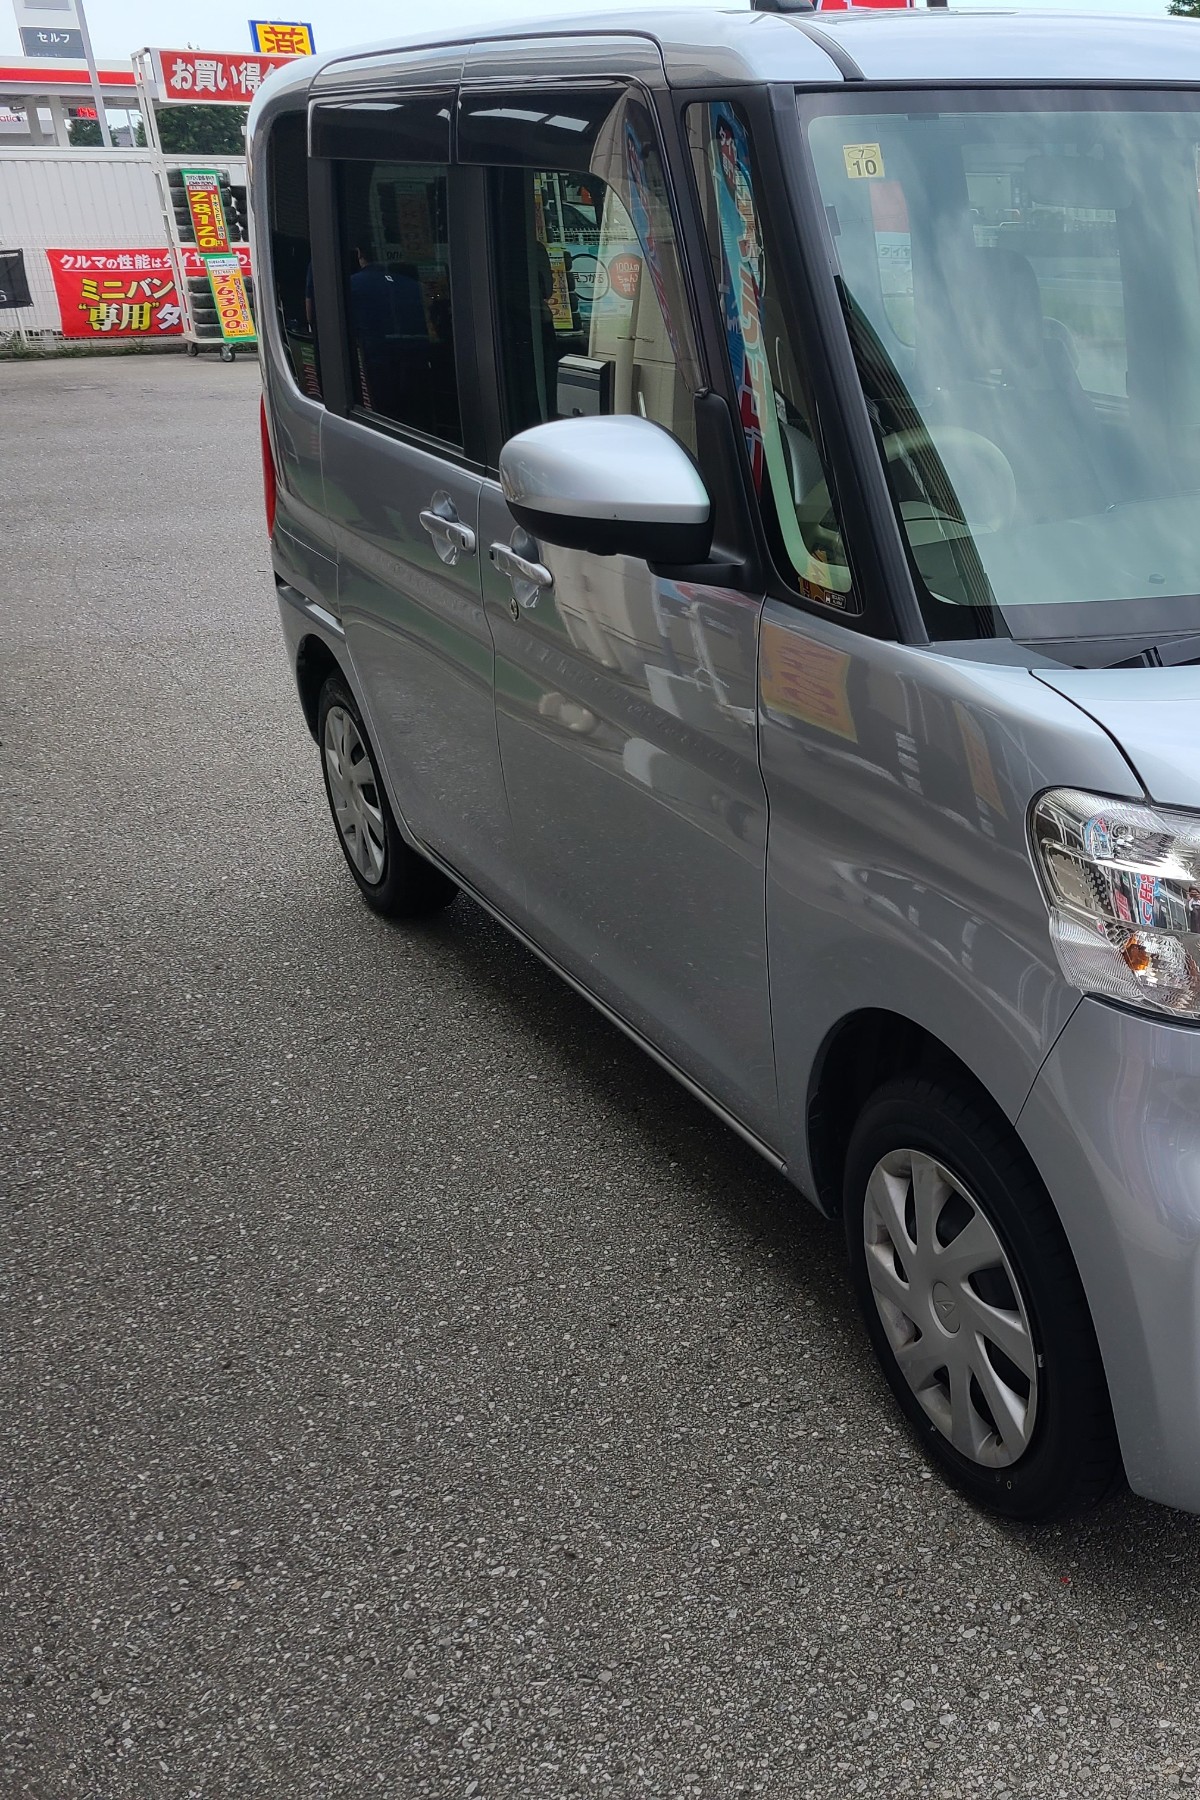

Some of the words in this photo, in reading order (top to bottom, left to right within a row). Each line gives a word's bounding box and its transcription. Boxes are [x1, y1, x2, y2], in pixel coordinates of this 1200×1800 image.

[37, 31, 70, 43] セルフ
[170, 58, 277, 94] お買い得
[858, 149, 865, 159] 7
[852, 159, 877, 176] 10
[80, 278, 175, 300] ミニバン
